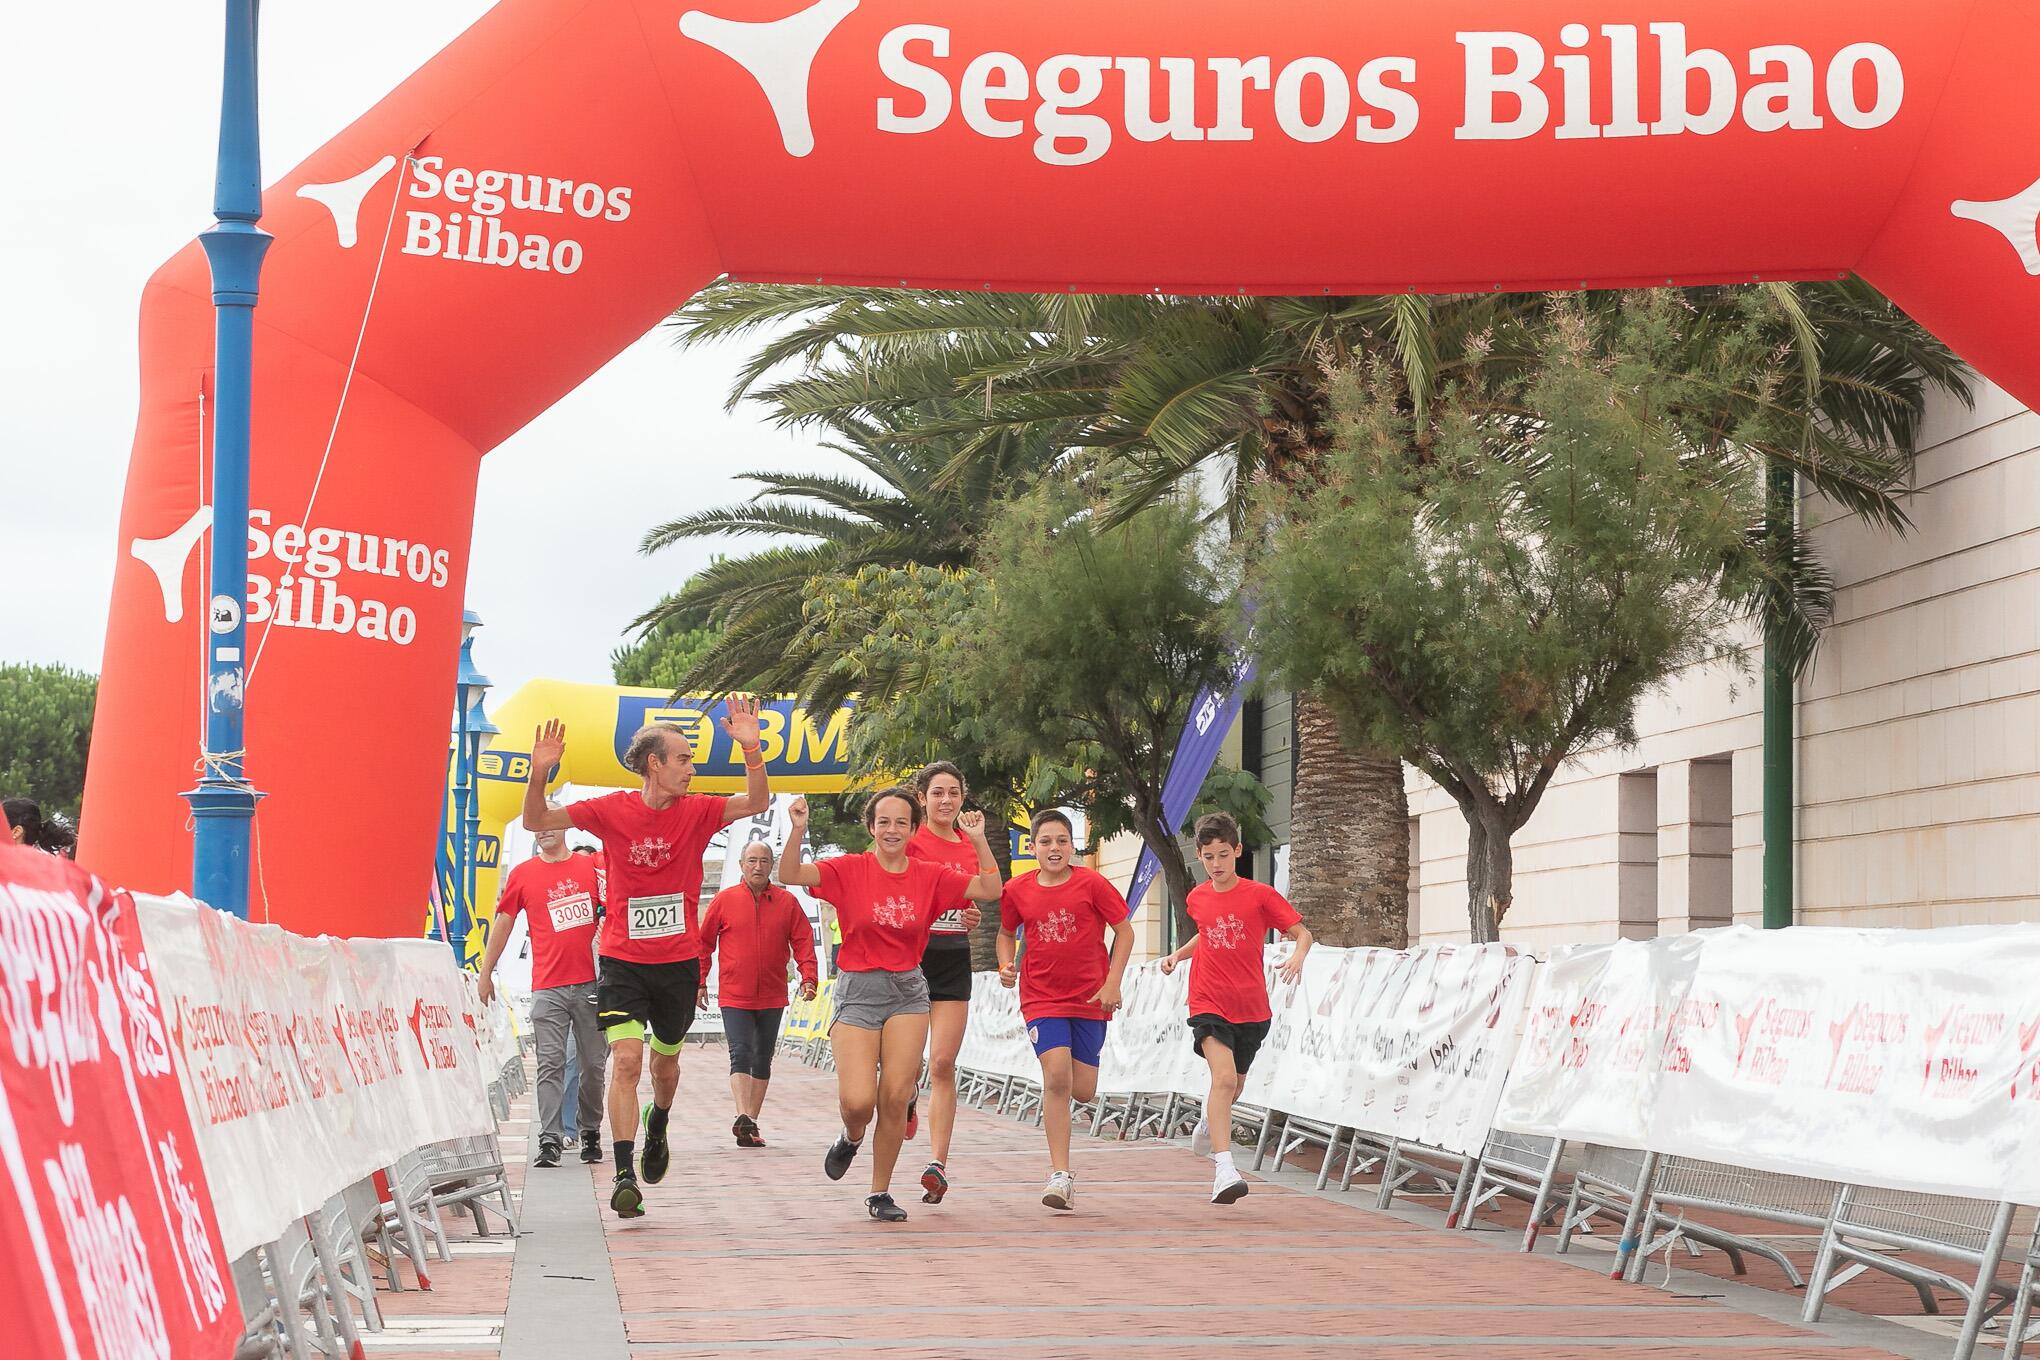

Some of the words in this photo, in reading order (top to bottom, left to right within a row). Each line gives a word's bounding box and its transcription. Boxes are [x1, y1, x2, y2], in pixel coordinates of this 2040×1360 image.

[877, 23, 1419, 167] Seguros
[1454, 22, 1904, 141] Bilbao
[409, 155, 632, 222] Seguros
[401, 211, 583, 275] Bilbao
[247, 508, 449, 589] Seguros
[245, 574, 417, 645] Bilbao
[555, 902, 589, 923] 3008
[634, 905, 677, 928] 2021
